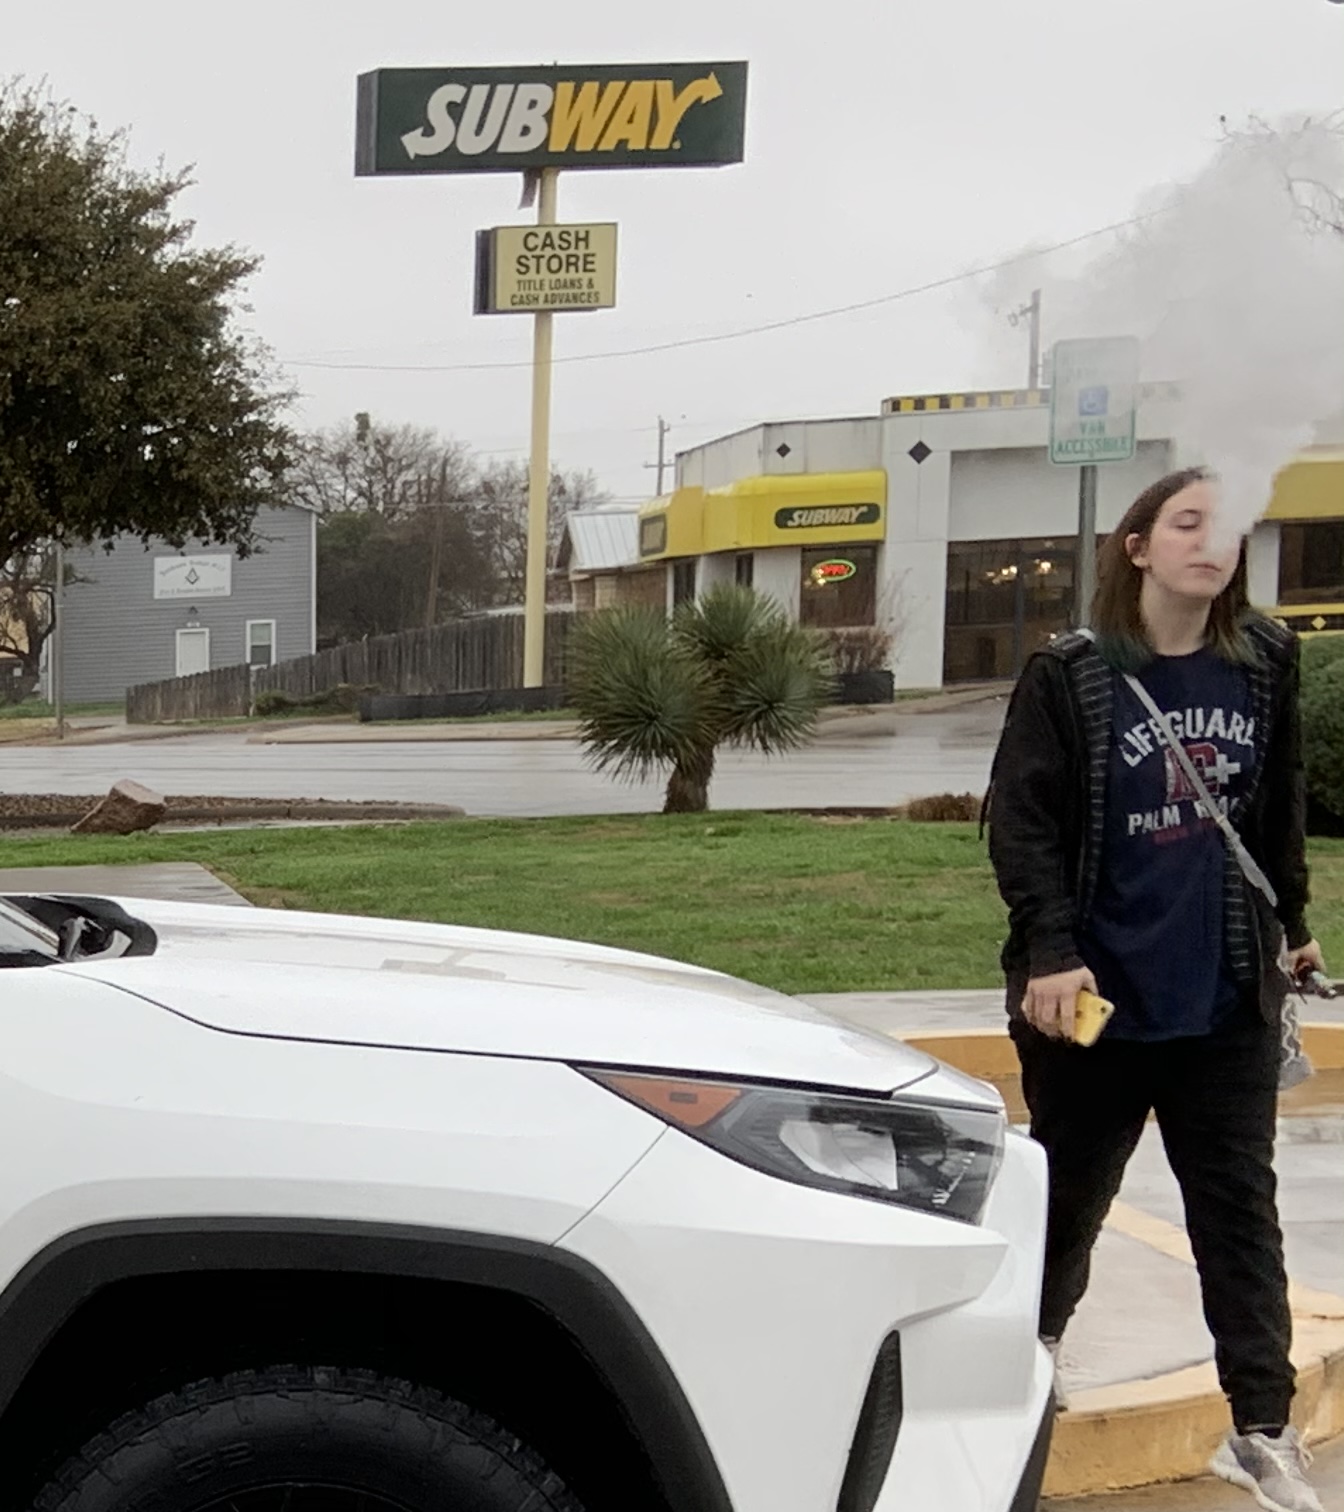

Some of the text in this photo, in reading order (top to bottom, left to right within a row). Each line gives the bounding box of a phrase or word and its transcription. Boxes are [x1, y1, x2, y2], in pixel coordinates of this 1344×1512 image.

[401, 72, 723, 159] SUBWAY
[523, 230, 590, 252] CASH
[515, 253, 596, 275] STORE
[516, 278, 595, 292] TITLE LOANS &
[510, 291, 600, 306] CASH ADVANCES
[1079, 420, 1106, 435] VAN
[786, 506, 869, 527] SUBWAY
[1126, 804, 1182, 836] PALM
